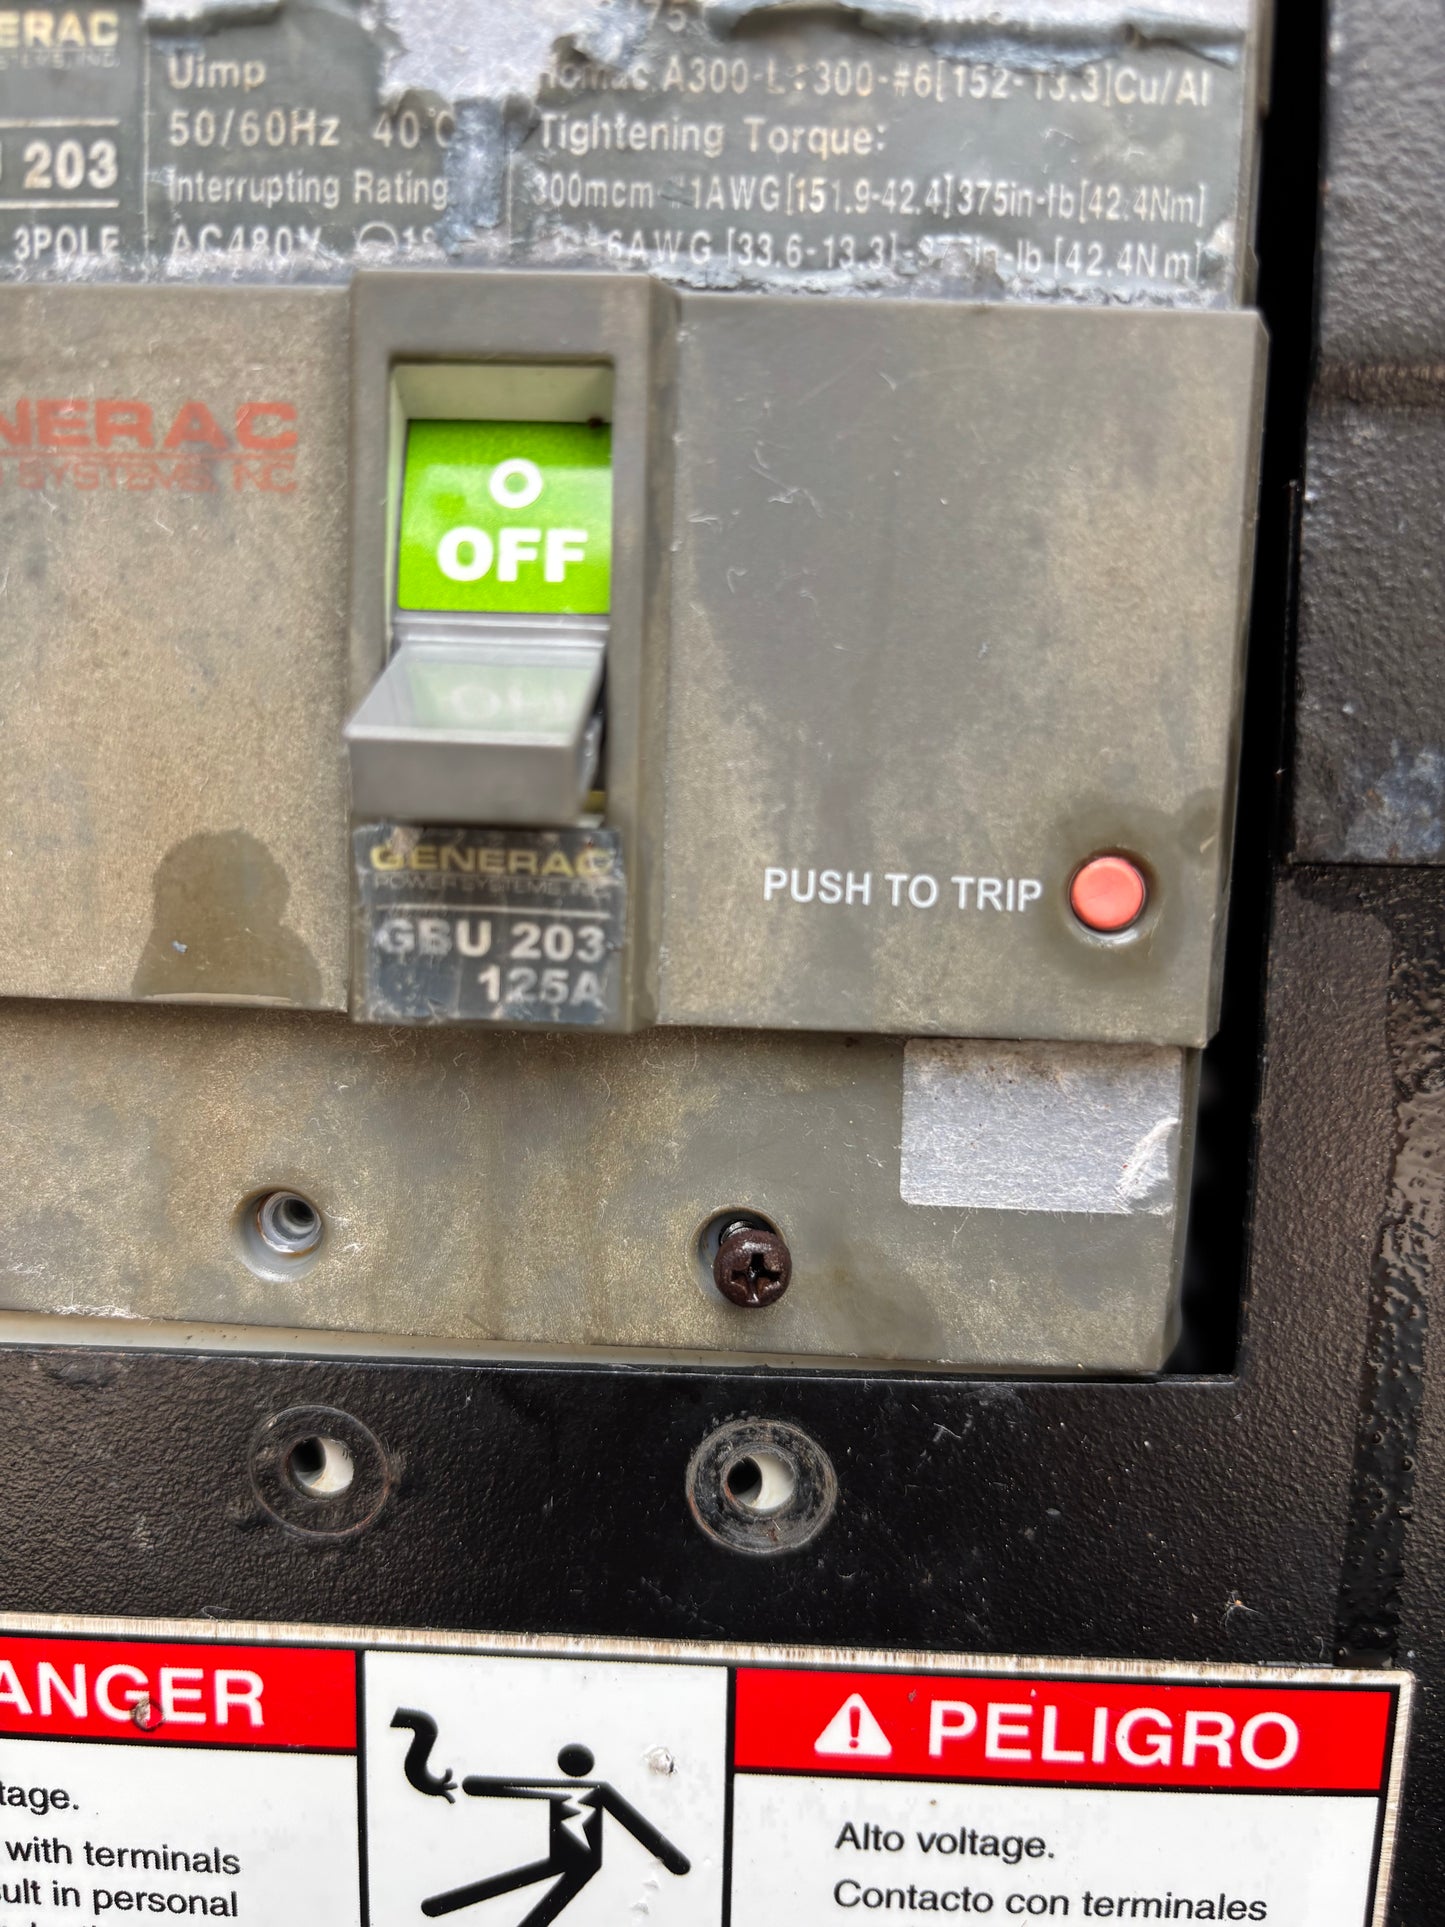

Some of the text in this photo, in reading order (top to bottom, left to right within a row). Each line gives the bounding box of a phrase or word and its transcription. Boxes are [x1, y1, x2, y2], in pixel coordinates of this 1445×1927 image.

[167, 54, 267, 90] Uimp
[168, 108, 340, 148] 50/60Hz
[540, 113, 886, 161] Tightening Torque:
[23, 139, 119, 190] 203
[167, 168, 449, 211] Interrupting Rating
[13, 224, 121, 264] 3POLE
[0, 399, 299, 450] NERAC
[437, 526, 588, 582] OFF
[370, 844, 616, 877] GENERAC
[764, 867, 1043, 912] PUSH TO TRIP
[374, 918, 607, 963] GBU 203
[478, 965, 601, 1010] 125A
[0, 1659, 265, 1728] ANGER
[928, 1699, 1299, 1771] PELIGRO
[5, 1836, 242, 1875] with terminals
[834, 1822, 1056, 1866] Alto voltage.
[52, 1880, 81, 1907] in
[92, 1890, 239, 1917] personal
[833, 1879, 1268, 1922] Contacto con terminales
